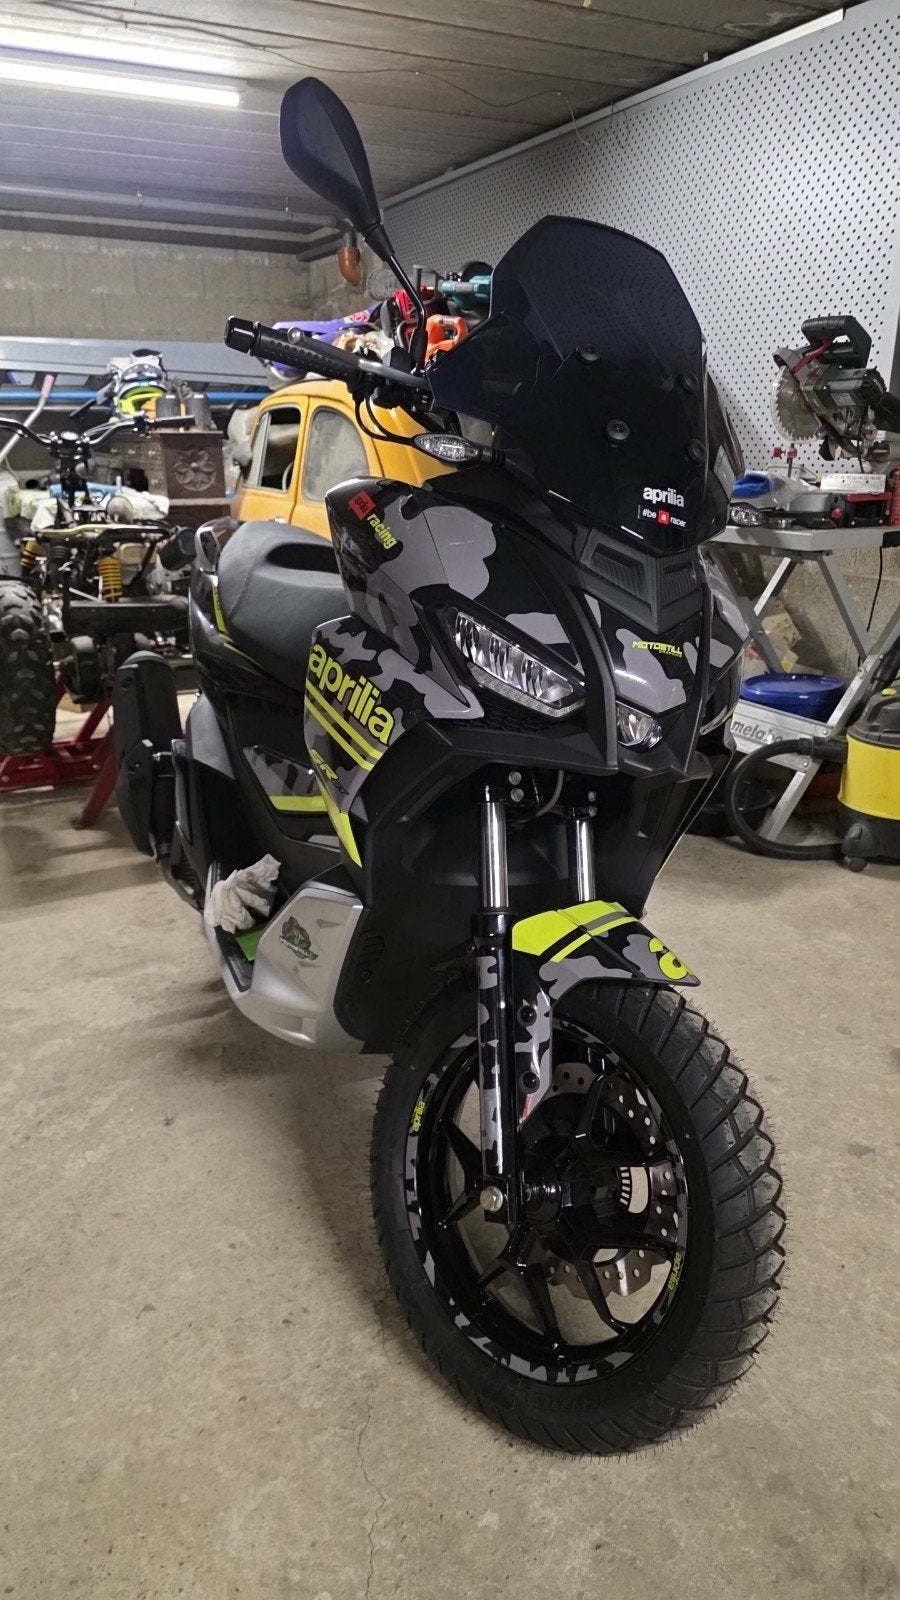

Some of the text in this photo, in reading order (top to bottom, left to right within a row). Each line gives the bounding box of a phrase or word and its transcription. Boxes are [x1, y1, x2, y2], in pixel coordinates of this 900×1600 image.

[642, 486, 685, 508] aprilia
[366, 513, 398, 550] racing
[642, 508, 657, 519] #be
[670, 516, 687, 528] racer
[308, 643, 394, 745] aprilia
[412, 1100, 426, 1132] aprilia
[667, 1251, 682, 1291] aprilia
